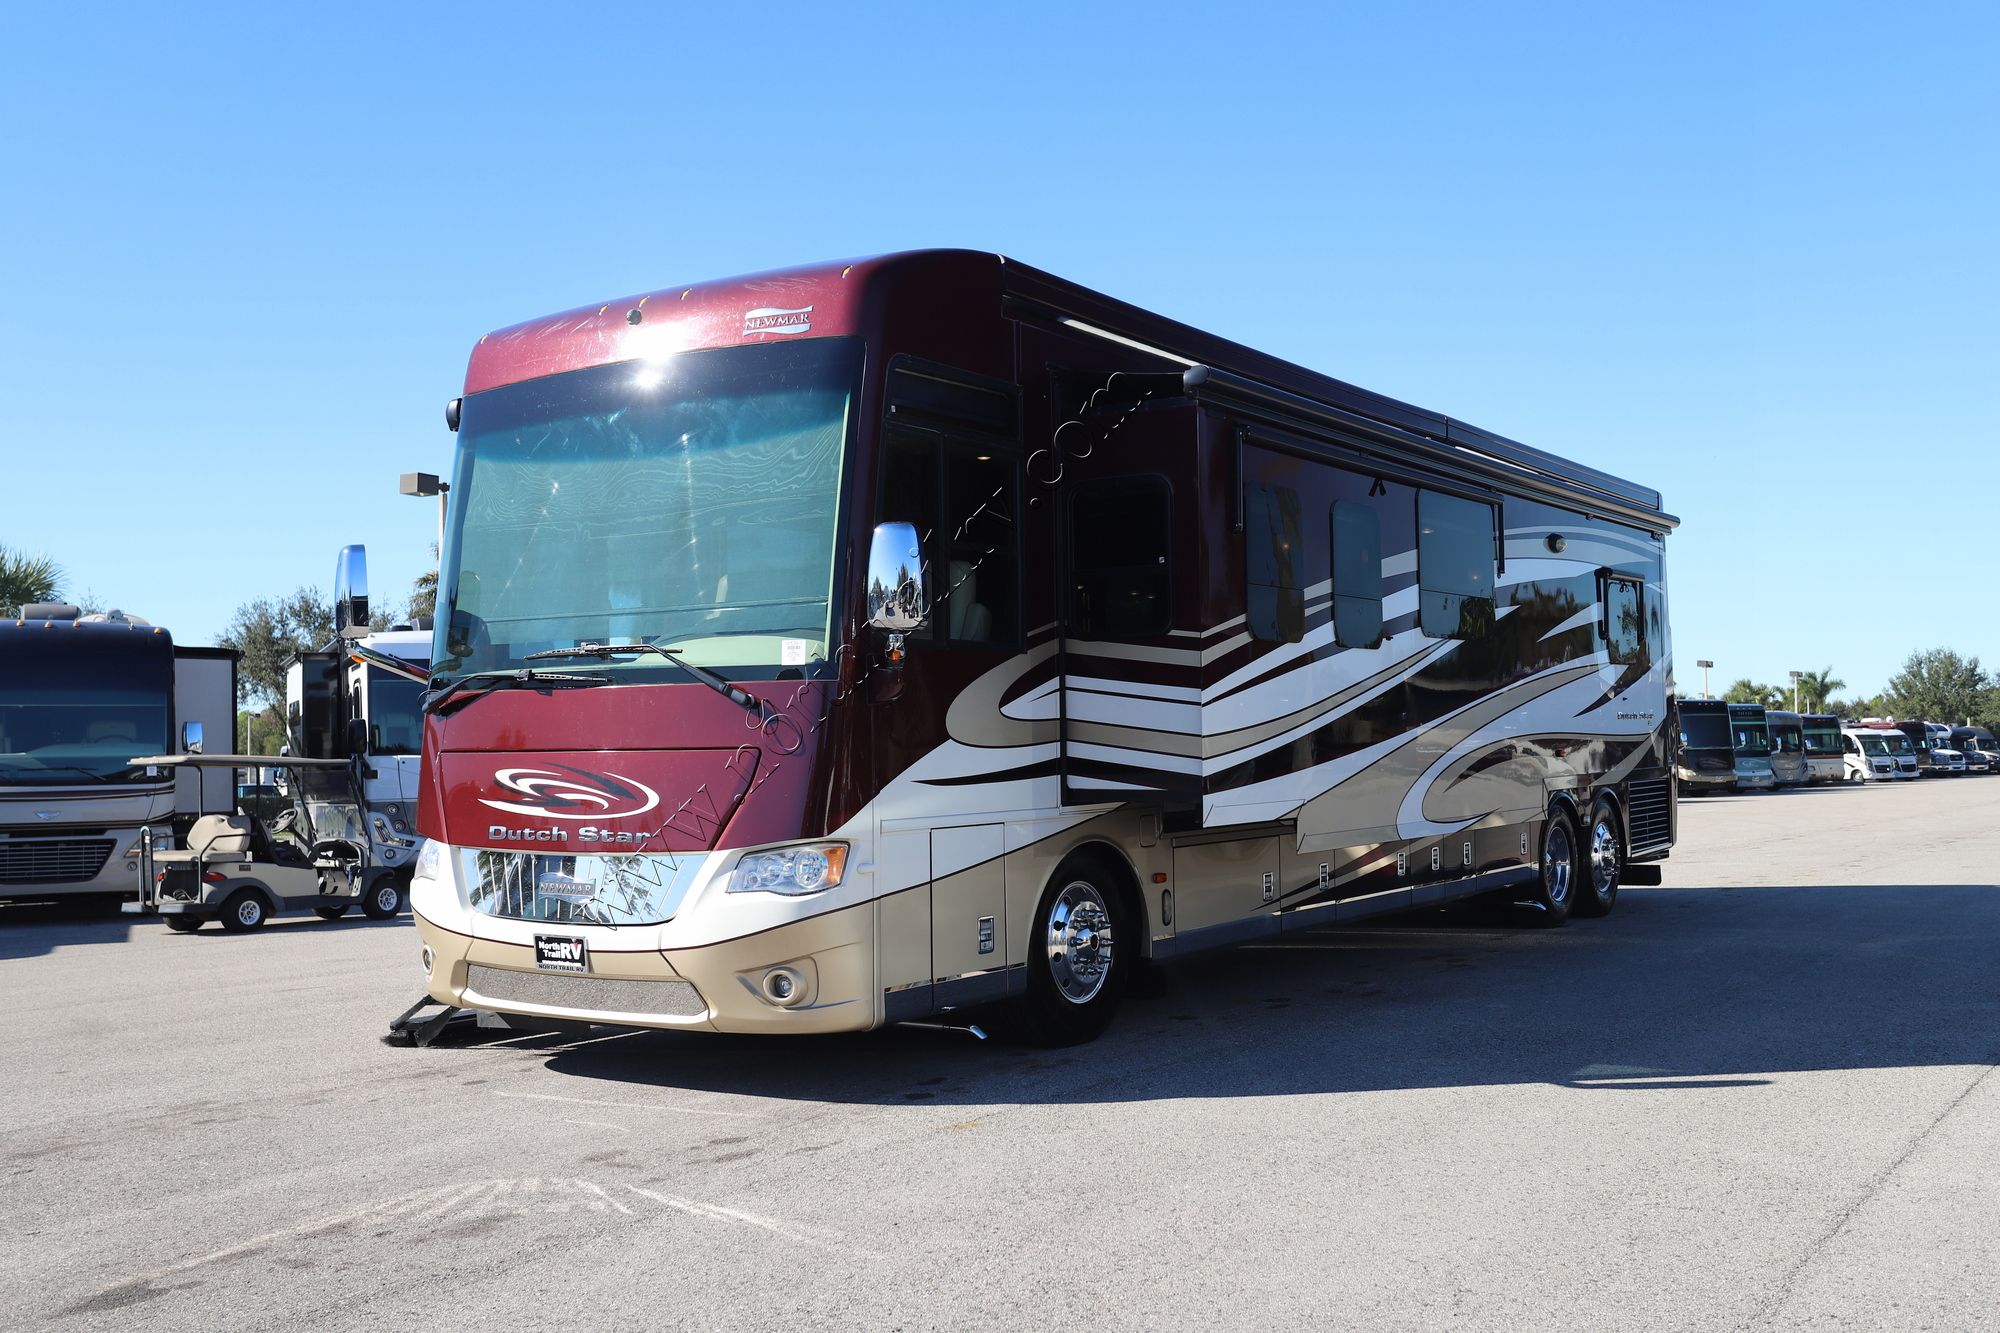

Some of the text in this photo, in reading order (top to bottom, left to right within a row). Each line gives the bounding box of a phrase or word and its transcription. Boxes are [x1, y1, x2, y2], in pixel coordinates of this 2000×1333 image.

[745, 313, 809, 329] NEWMAR
[488, 825, 651, 844] Dutch Star
[540, 883, 591, 895] NEWMAR
[538, 941, 582, 960] North RV
[542, 949, 560, 959] Trail
